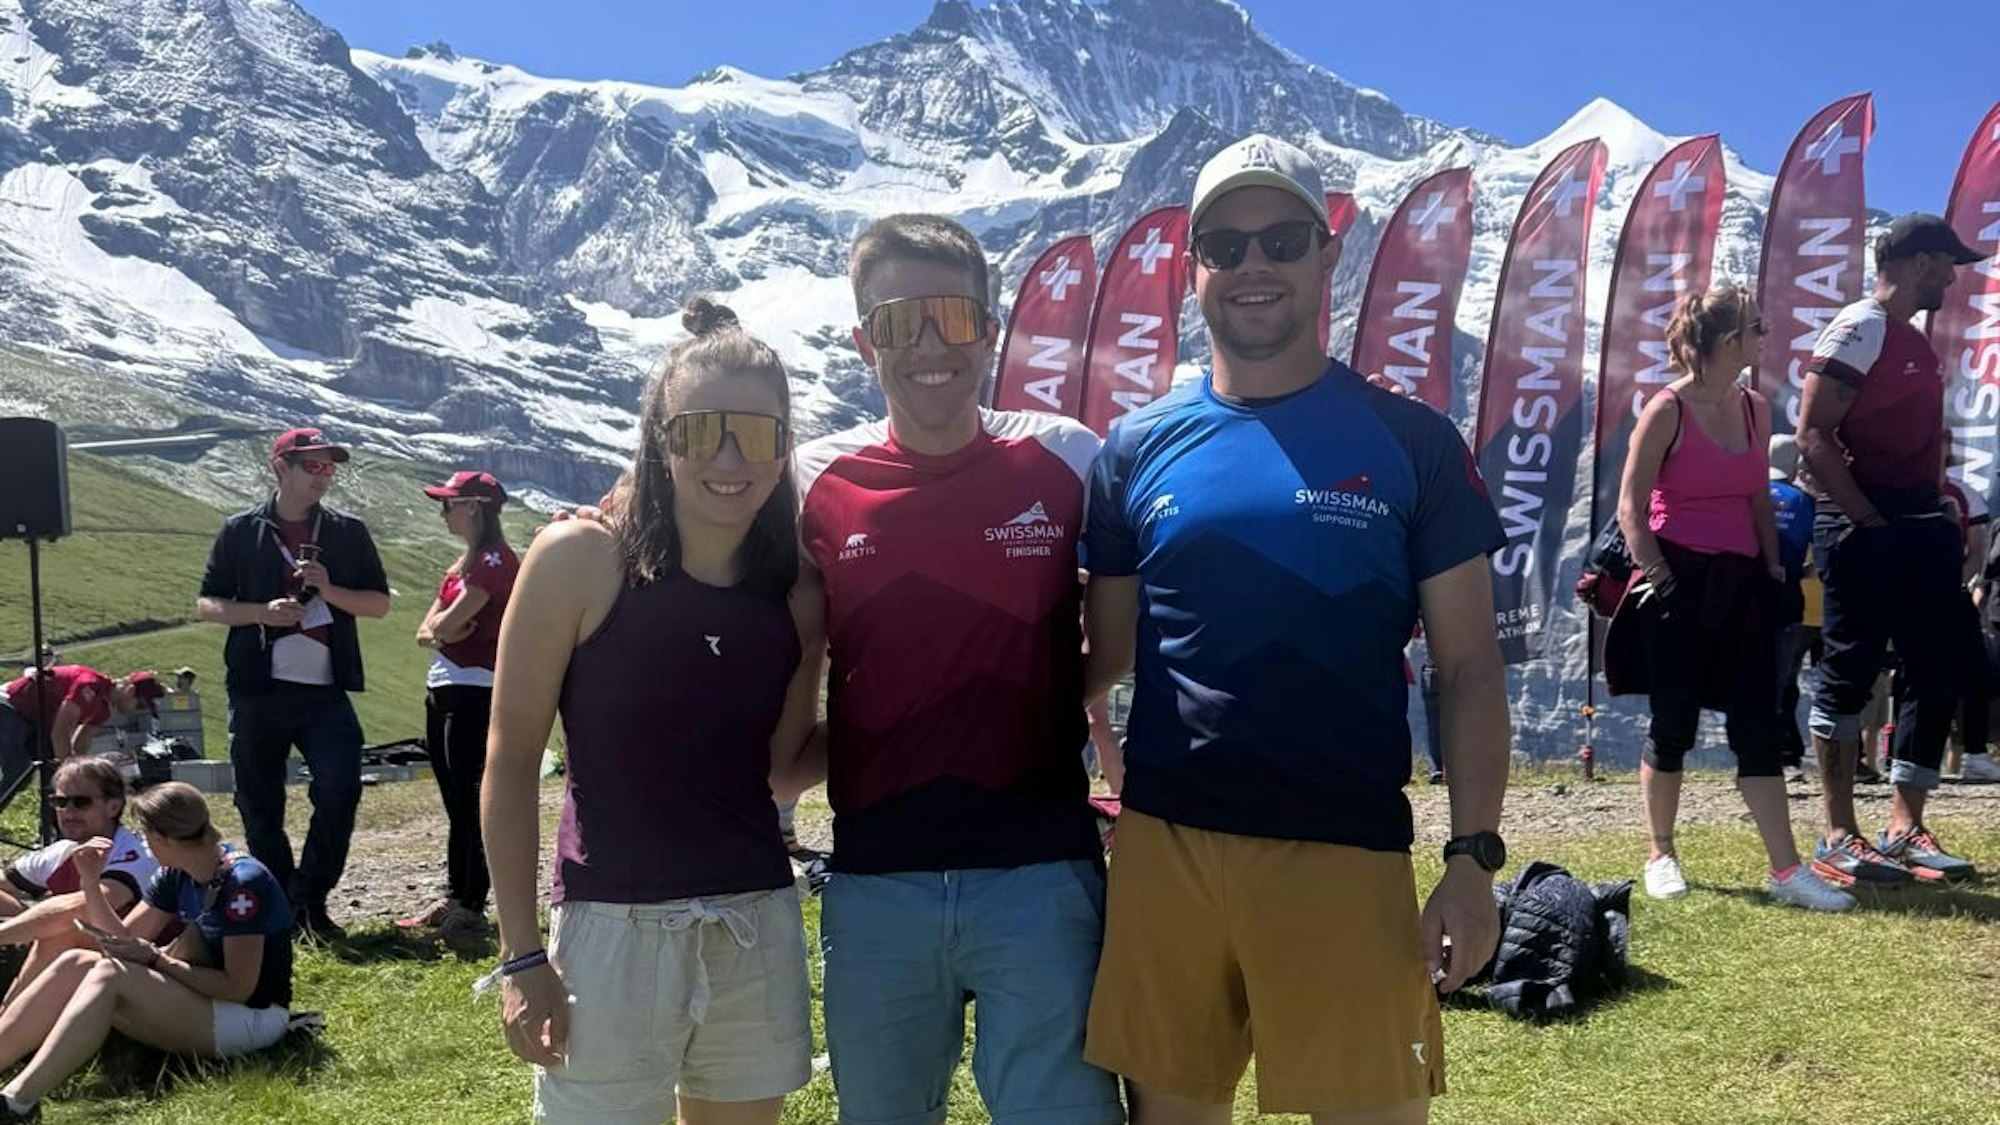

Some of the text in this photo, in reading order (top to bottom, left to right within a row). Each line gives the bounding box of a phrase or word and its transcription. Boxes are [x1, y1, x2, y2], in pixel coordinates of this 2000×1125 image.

[1021, 335, 1071, 415] AN
[1493, 259, 1577, 579] SWISSMAN
[1294, 488, 1390, 516] SWISSMAN
[1312, 512, 1368, 529] SUPPORTER
[984, 525, 1065, 542] SWISSMAN
[1005, 545, 1051, 558] FINISHER
[1496, 603, 1540, 625] REME
